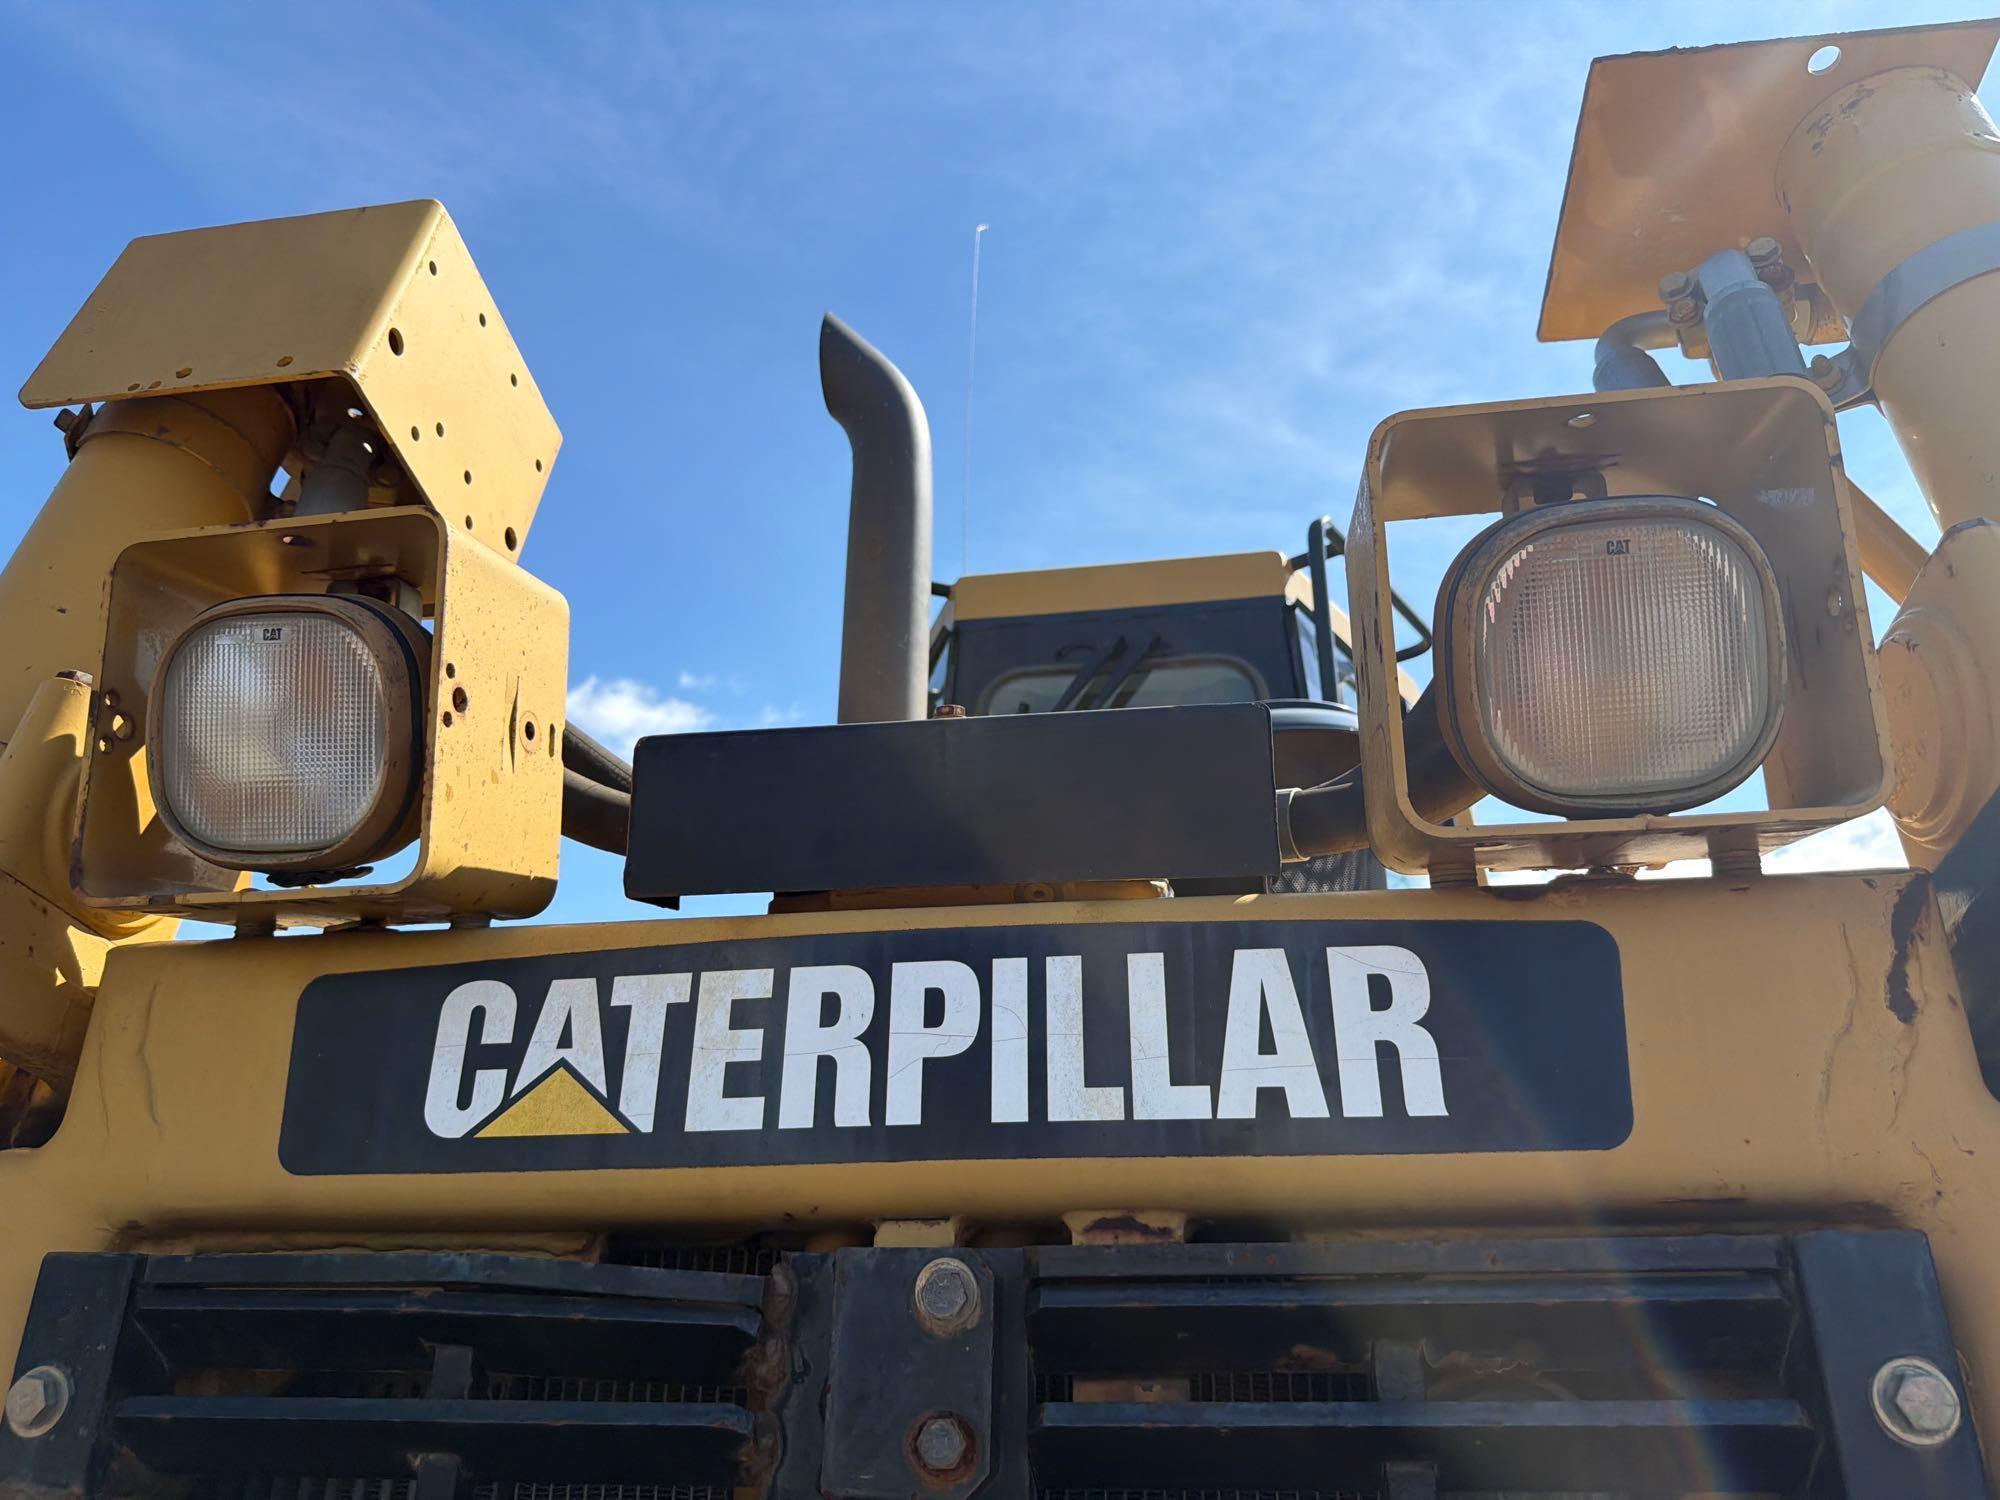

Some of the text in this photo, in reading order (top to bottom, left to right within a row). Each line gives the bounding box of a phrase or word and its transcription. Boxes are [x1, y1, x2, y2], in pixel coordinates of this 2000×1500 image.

[1606, 539, 1631, 555] CAT
[262, 628, 282, 641] CAT
[423, 945, 1449, 1138] CATERPILLAR
